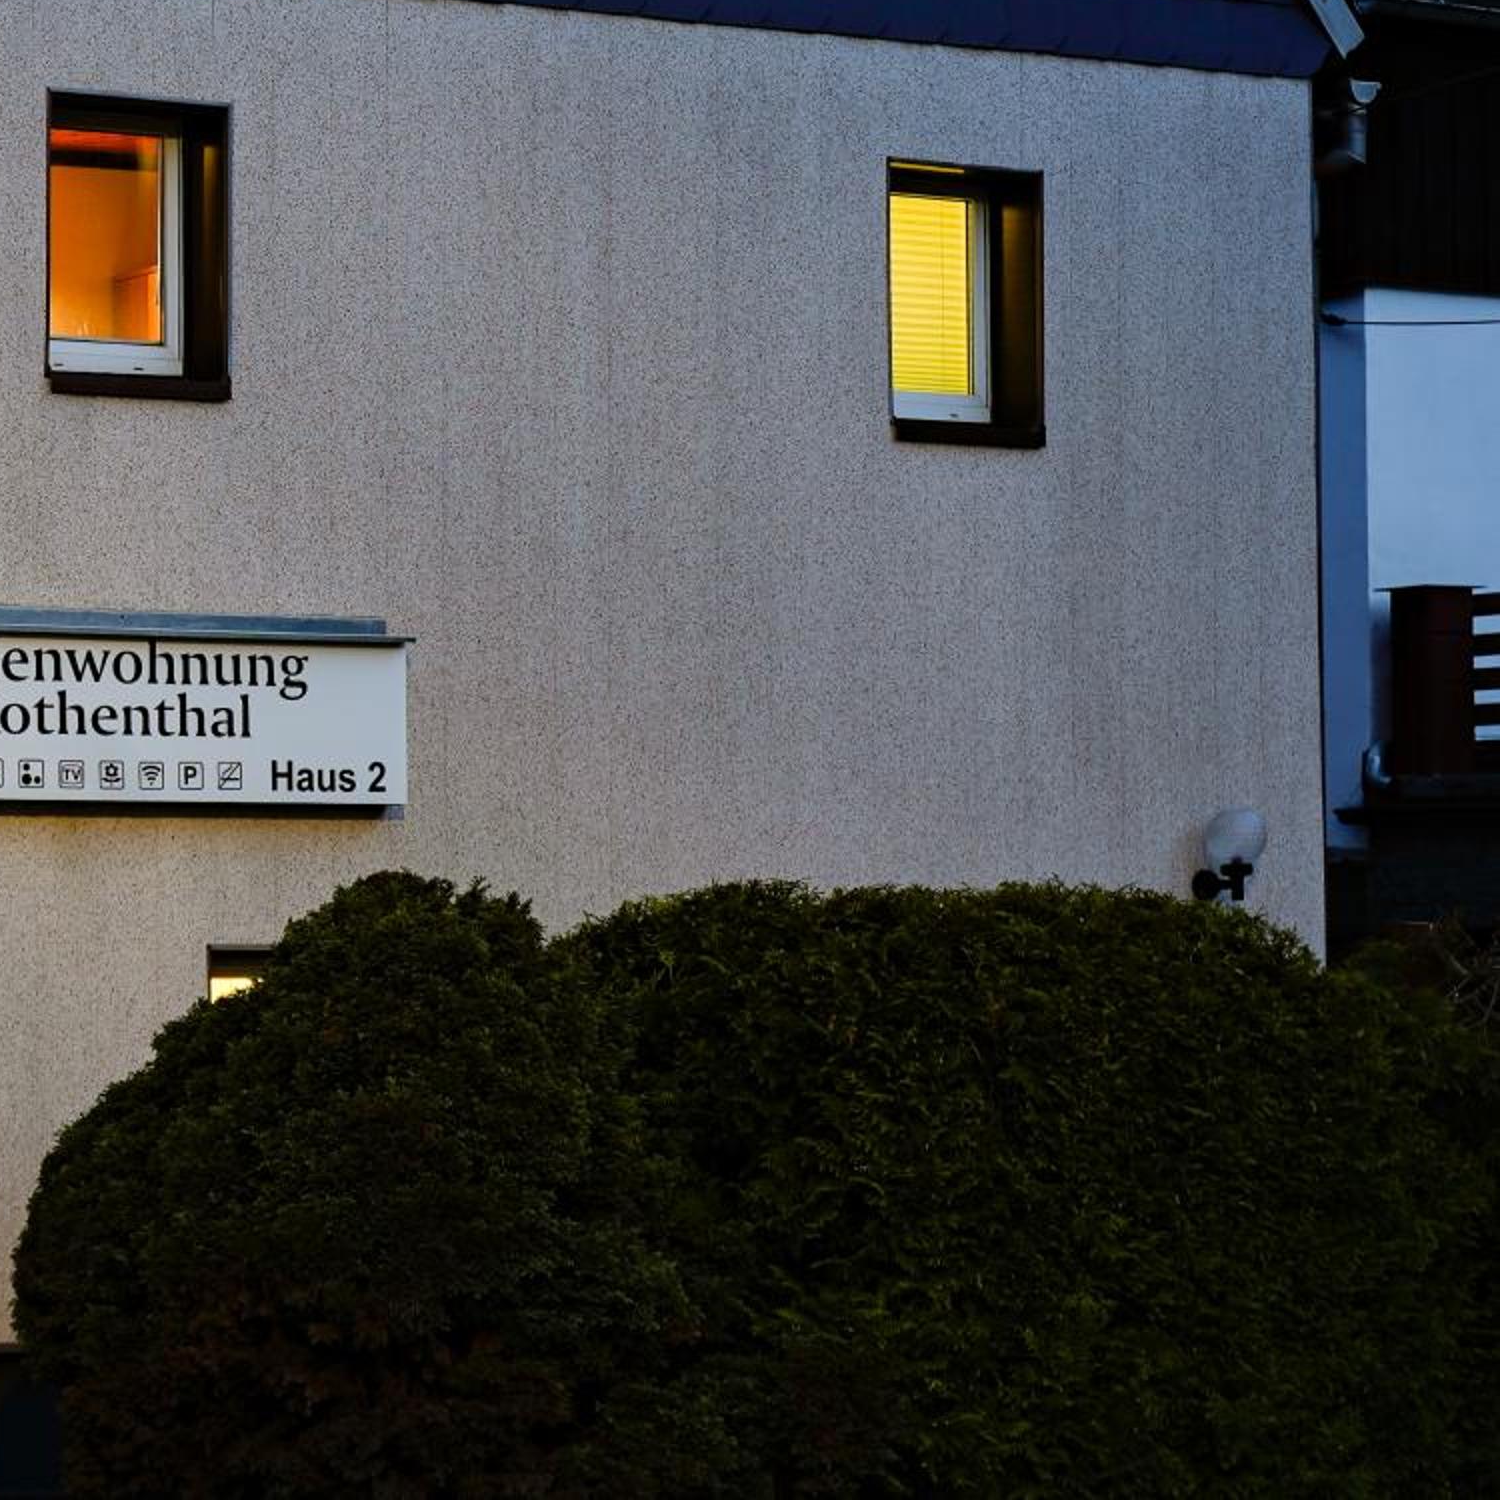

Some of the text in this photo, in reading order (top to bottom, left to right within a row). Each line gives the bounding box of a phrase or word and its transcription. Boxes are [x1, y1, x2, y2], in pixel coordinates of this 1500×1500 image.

[62, 767, 82, 782] TV
[183, 765, 198, 786] P
[271, 759, 387, 793] Haus 2
